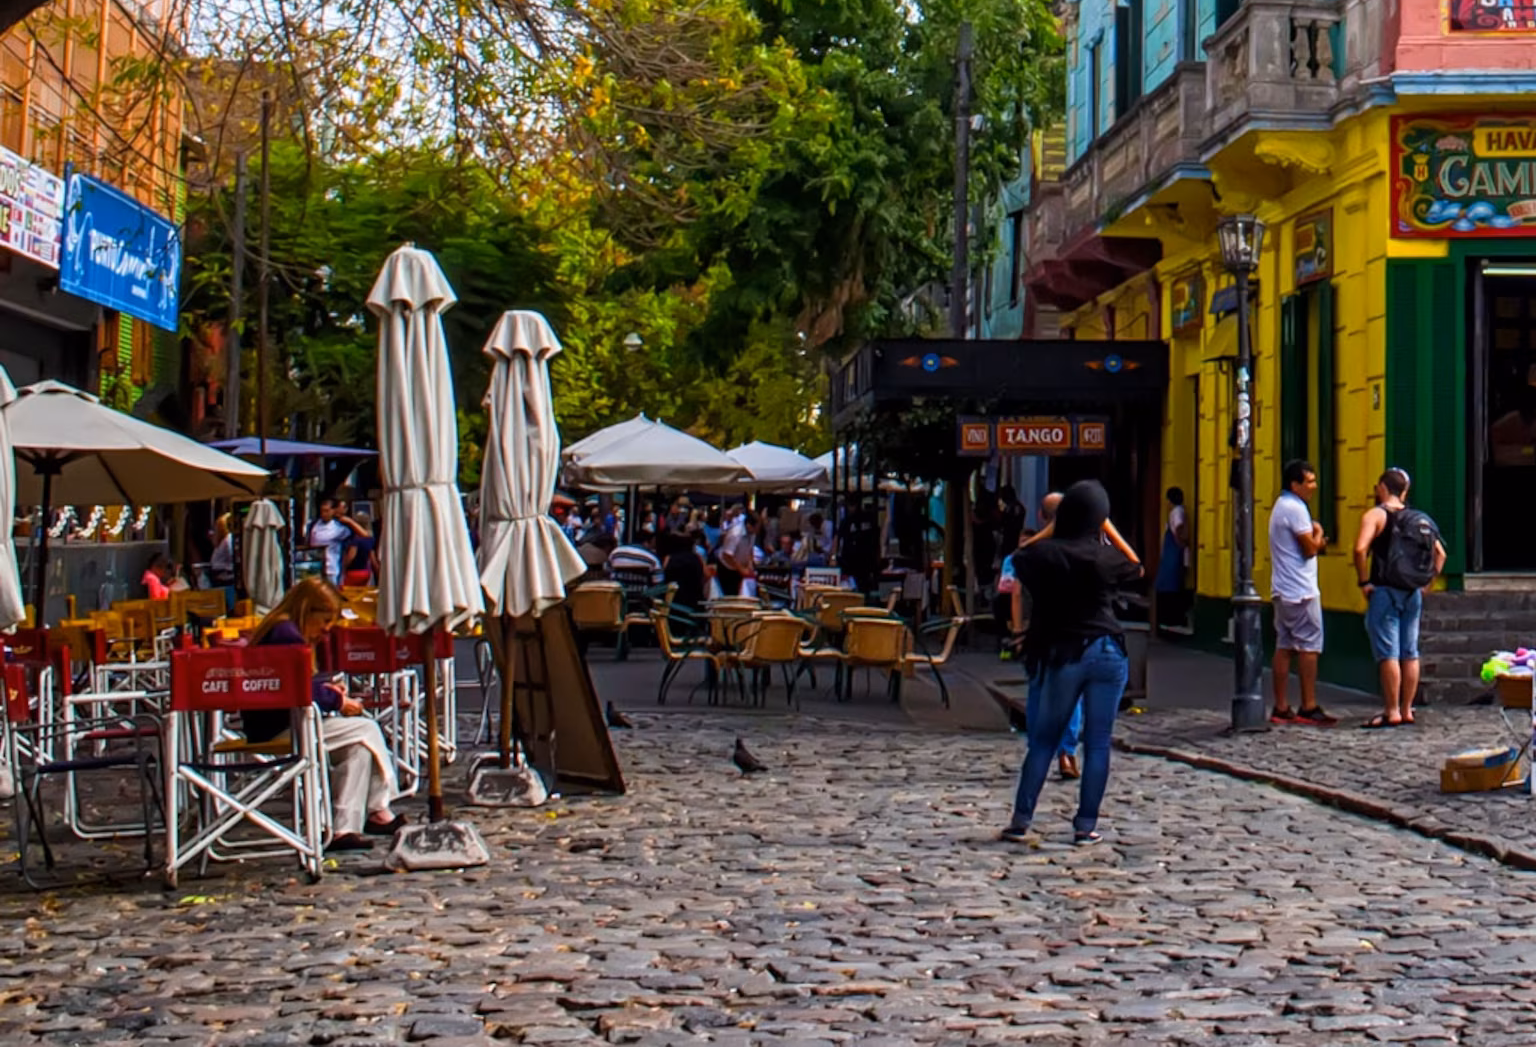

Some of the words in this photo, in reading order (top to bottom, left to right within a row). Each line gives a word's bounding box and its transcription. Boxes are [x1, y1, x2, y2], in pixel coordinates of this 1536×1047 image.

[1005, 427, 1064, 444] TANGO
[202, 680, 229, 693] CAFE
[242, 678, 281, 692] COFFEE
